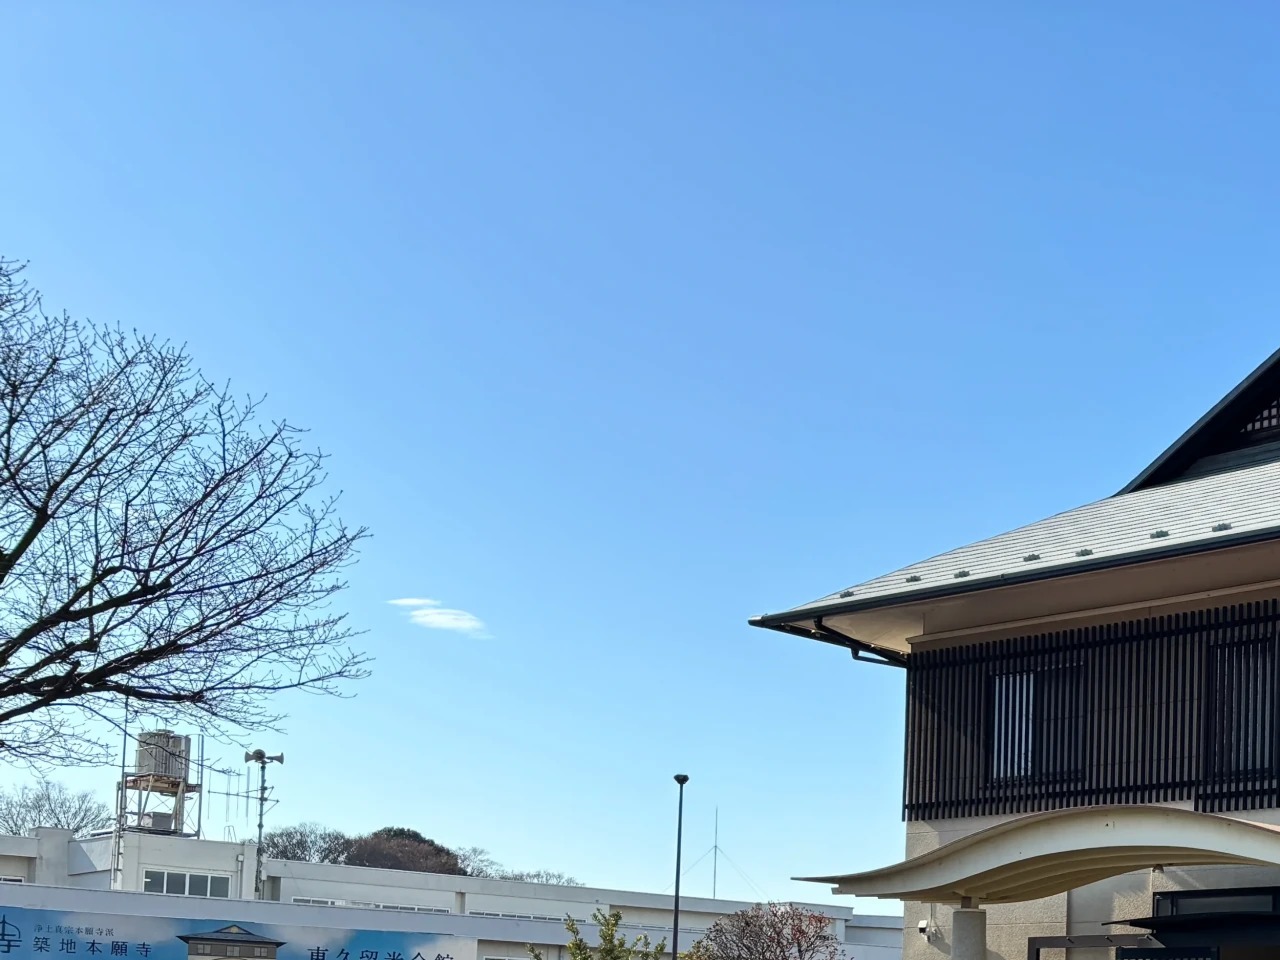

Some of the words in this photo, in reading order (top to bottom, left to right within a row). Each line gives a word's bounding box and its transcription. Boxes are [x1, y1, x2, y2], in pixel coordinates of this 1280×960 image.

[34, 924, 114, 937] 浄土真宗本願寺派
[33, 937, 152, 958] 築地本願寺
